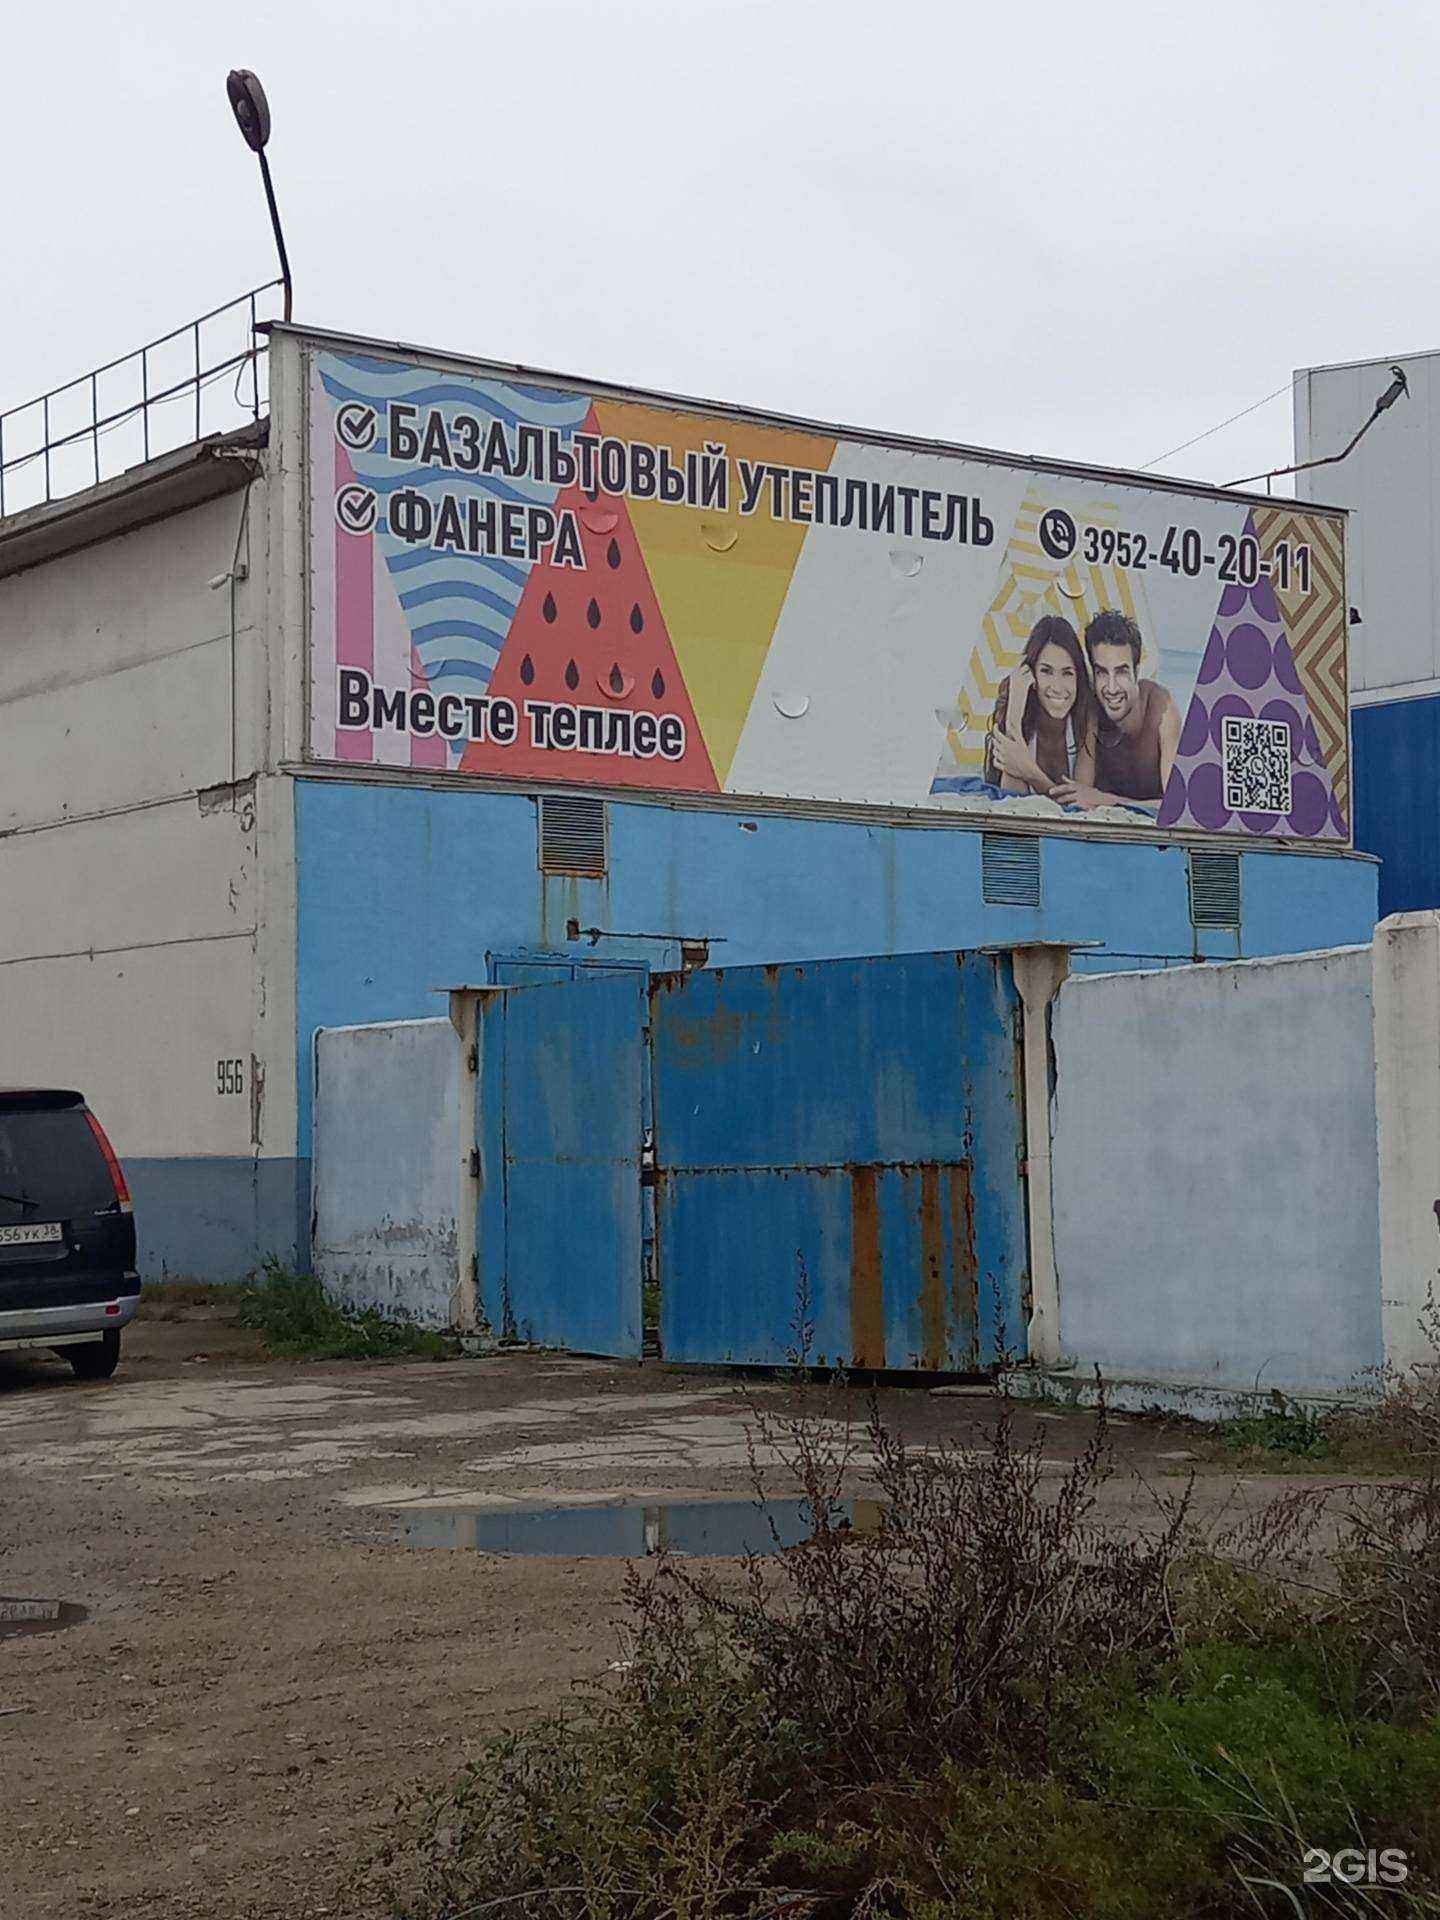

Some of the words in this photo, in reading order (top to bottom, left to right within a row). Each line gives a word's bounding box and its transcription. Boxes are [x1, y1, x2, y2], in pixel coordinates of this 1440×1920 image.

[389, 404, 728, 512] БАЗАЛЬТОВЫЙ
[738, 461, 994, 546] УТЕПЛИТЕЛЬ
[389, 490, 584, 569] ФАНЕРА
[1083, 526, 1309, 592] 3952-40-20-11
[339, 669, 516, 745] Вместе
[528, 704, 684, 759] теплее
[217, 1059, 243, 1095] 956
